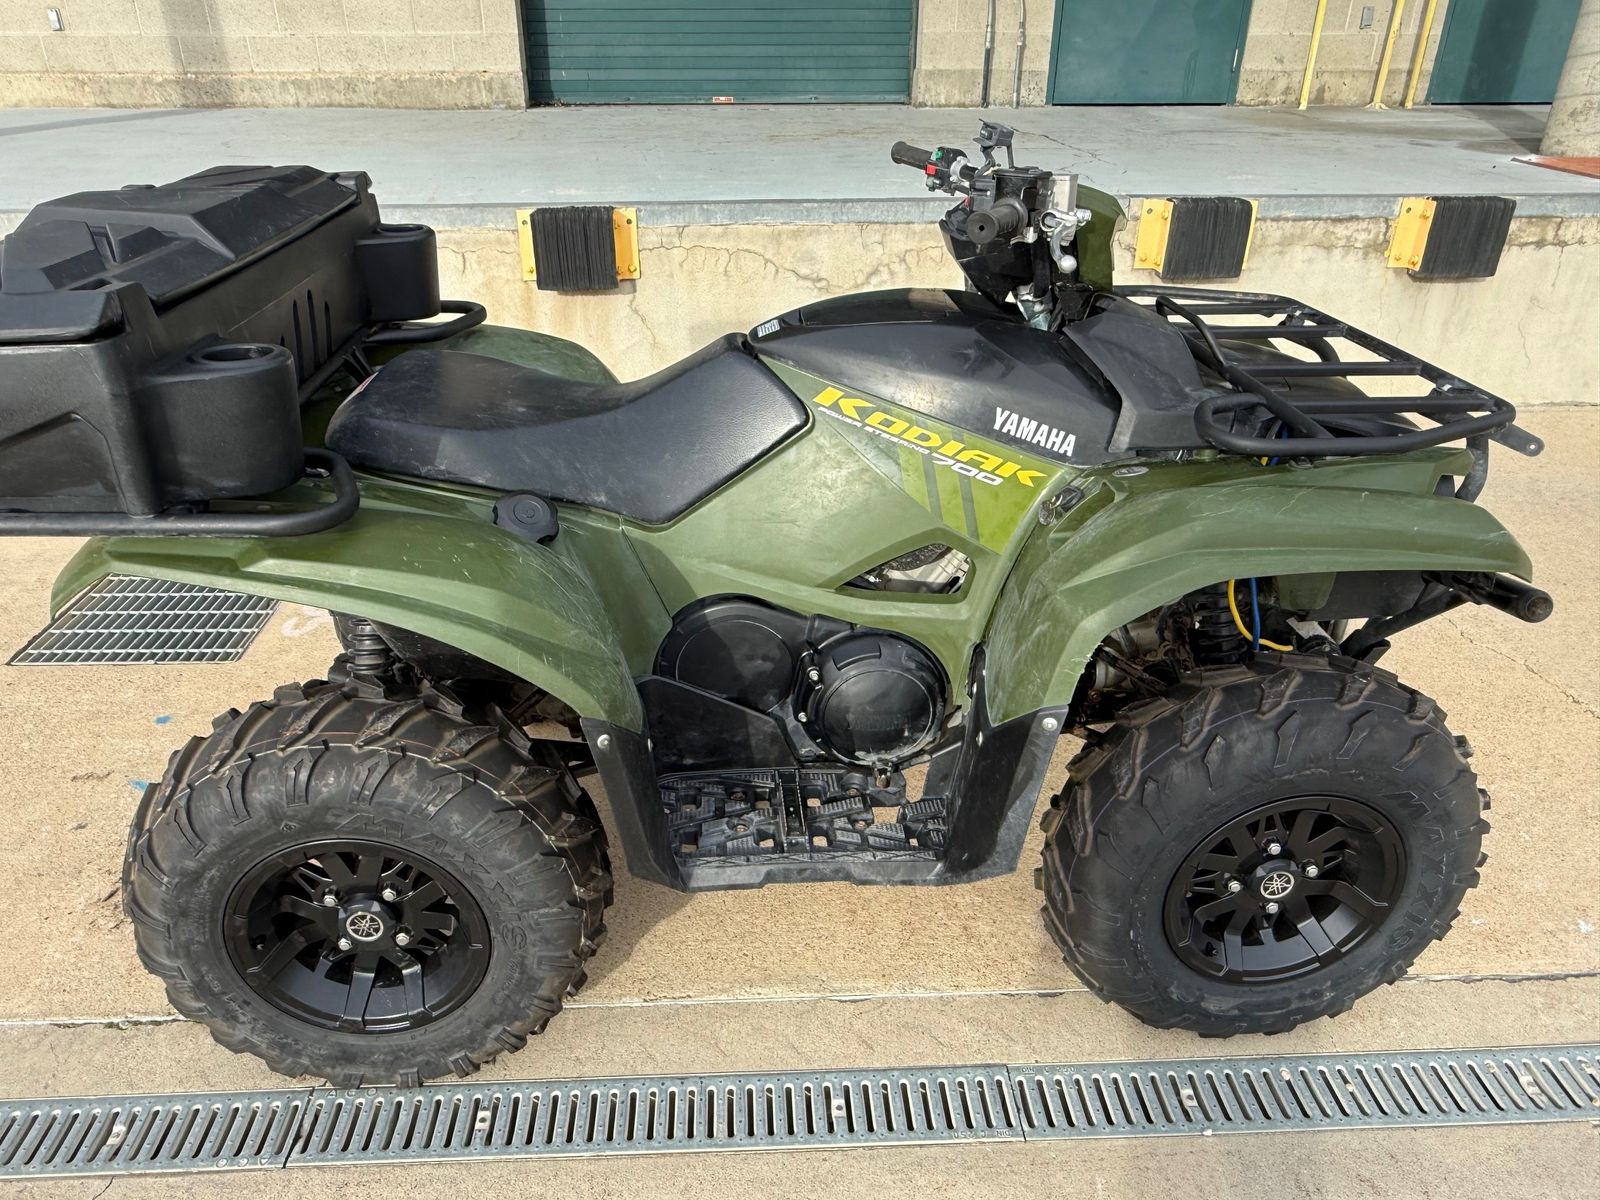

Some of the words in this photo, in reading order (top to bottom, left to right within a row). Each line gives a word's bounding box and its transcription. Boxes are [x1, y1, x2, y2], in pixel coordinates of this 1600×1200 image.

[812, 386, 1048, 487] KODIAK
[818, 406, 863, 428] POWER
[863, 425, 931, 455] STEERING
[931, 452, 1004, 486] 700
[993, 407, 1076, 457] YAMAHA
